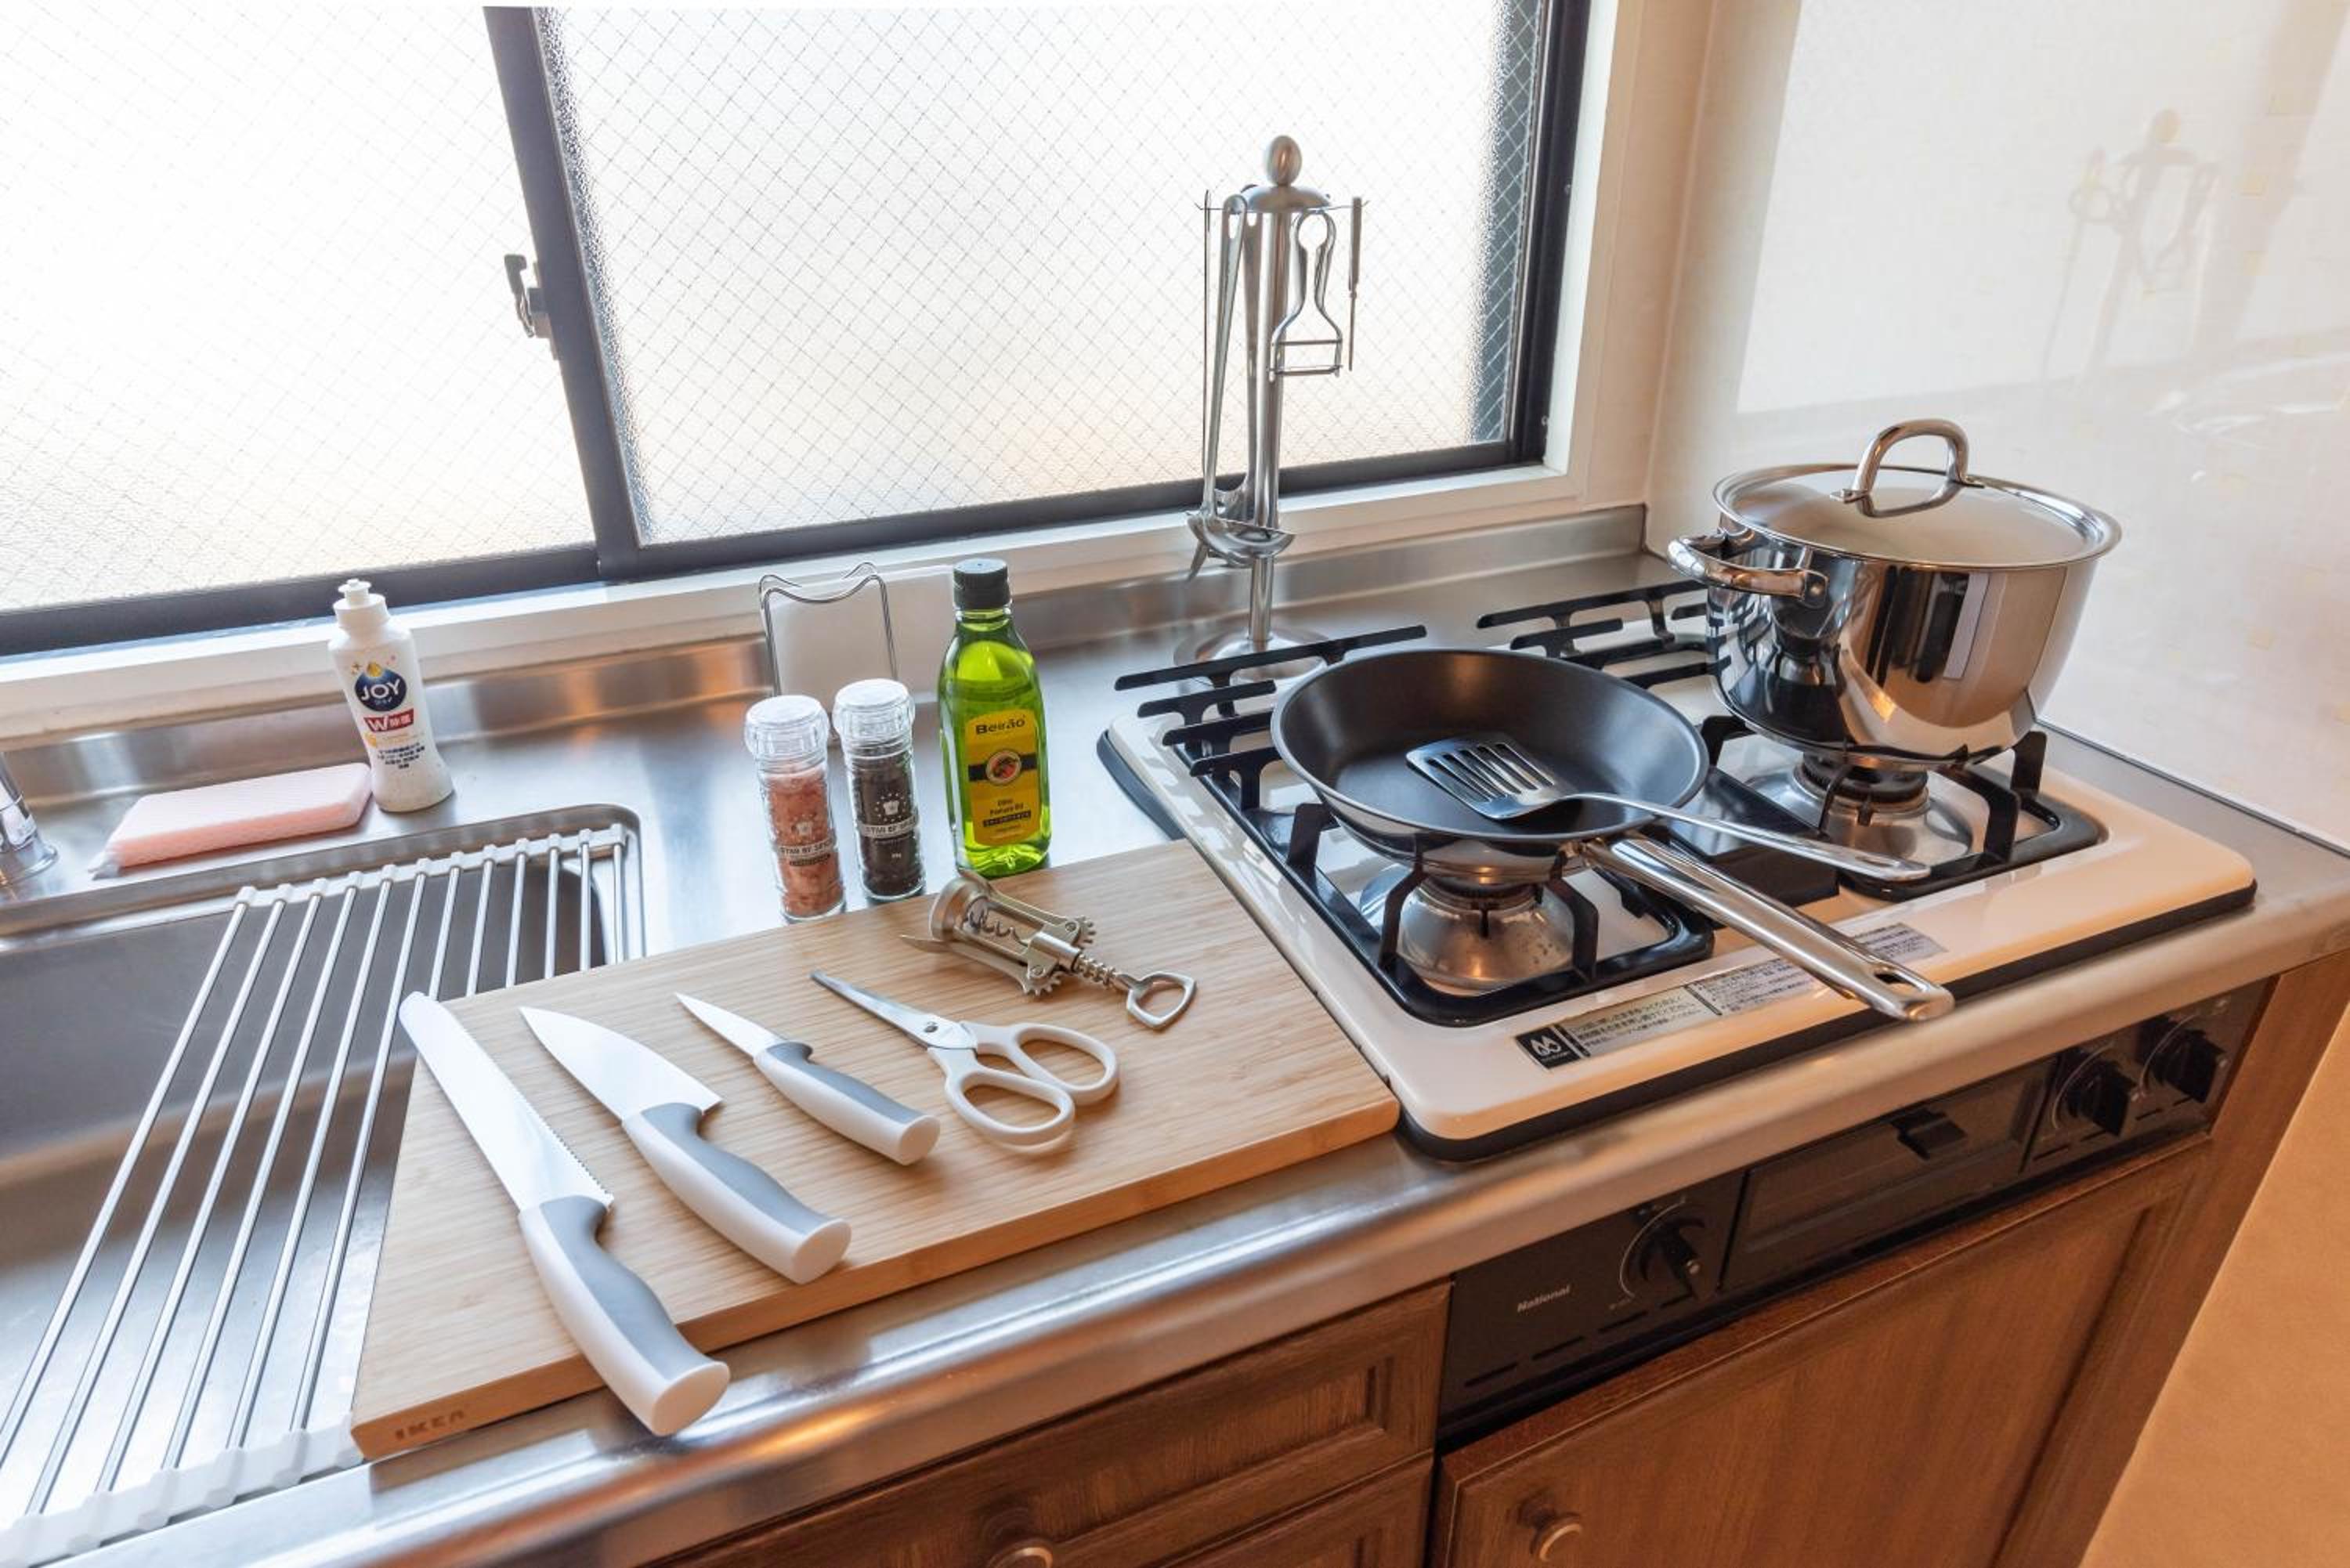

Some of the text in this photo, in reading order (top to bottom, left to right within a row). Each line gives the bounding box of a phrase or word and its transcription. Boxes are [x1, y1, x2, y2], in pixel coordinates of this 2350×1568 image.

[360, 678, 401, 701] JOY
[1517, 1284, 1571, 1313] National
[394, 1411, 465, 1440] IKEA
